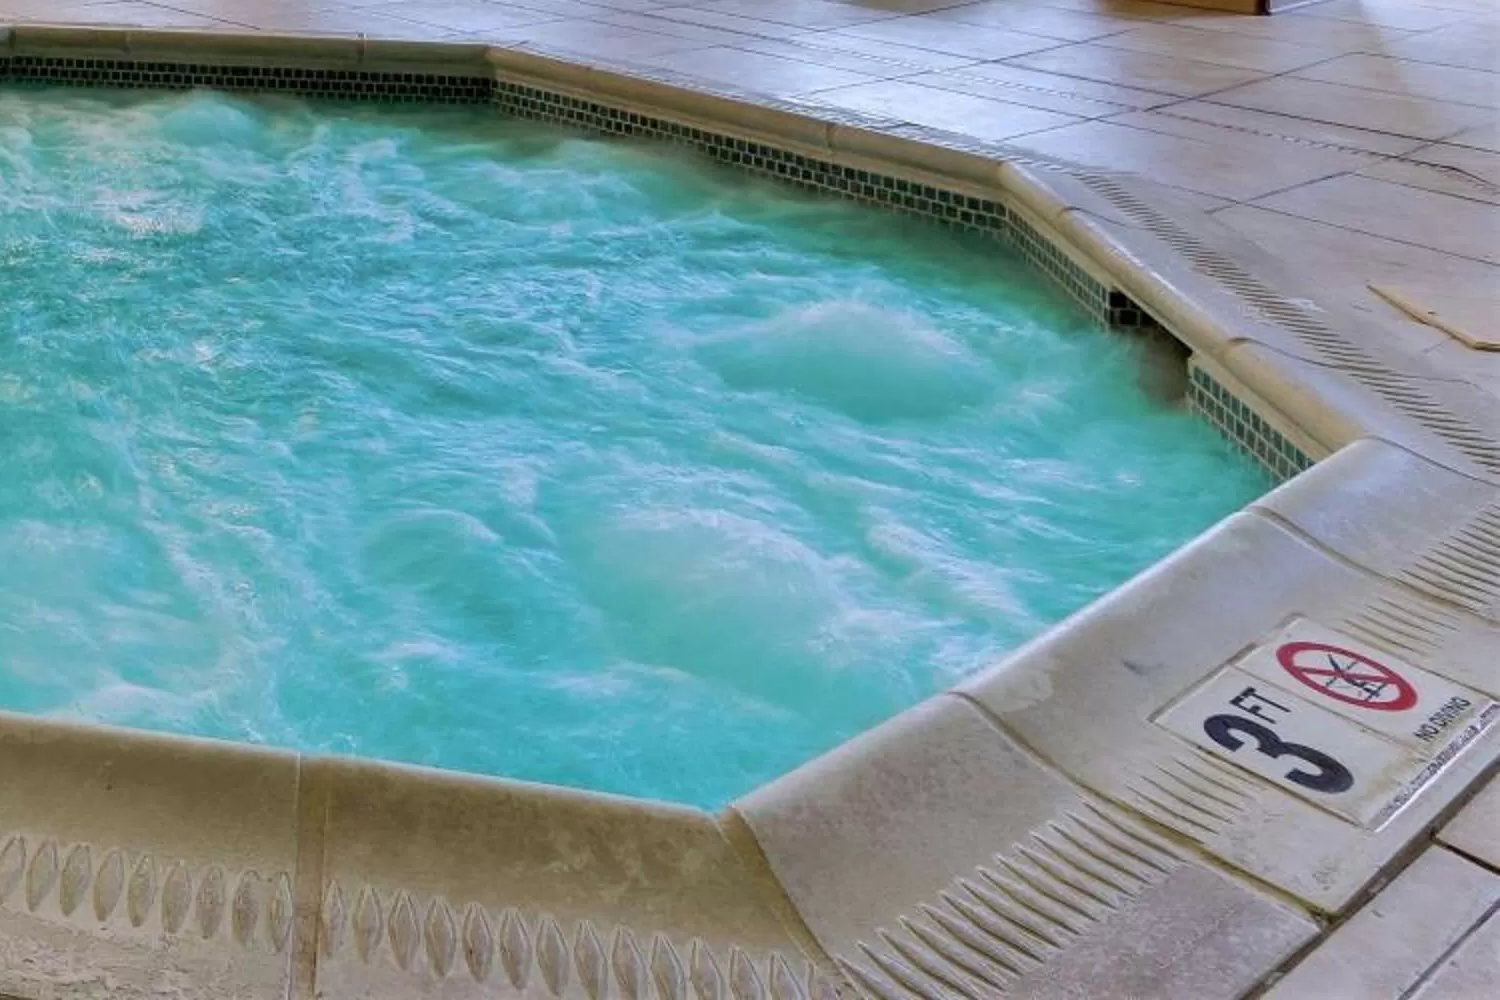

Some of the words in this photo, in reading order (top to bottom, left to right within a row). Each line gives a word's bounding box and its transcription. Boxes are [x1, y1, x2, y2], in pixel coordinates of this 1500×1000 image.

[1228, 686, 1293, 725] FT
[1413, 722, 1440, 743] NO
[1428, 695, 1472, 727] DIVING
[1203, 713, 1355, 795] 3
